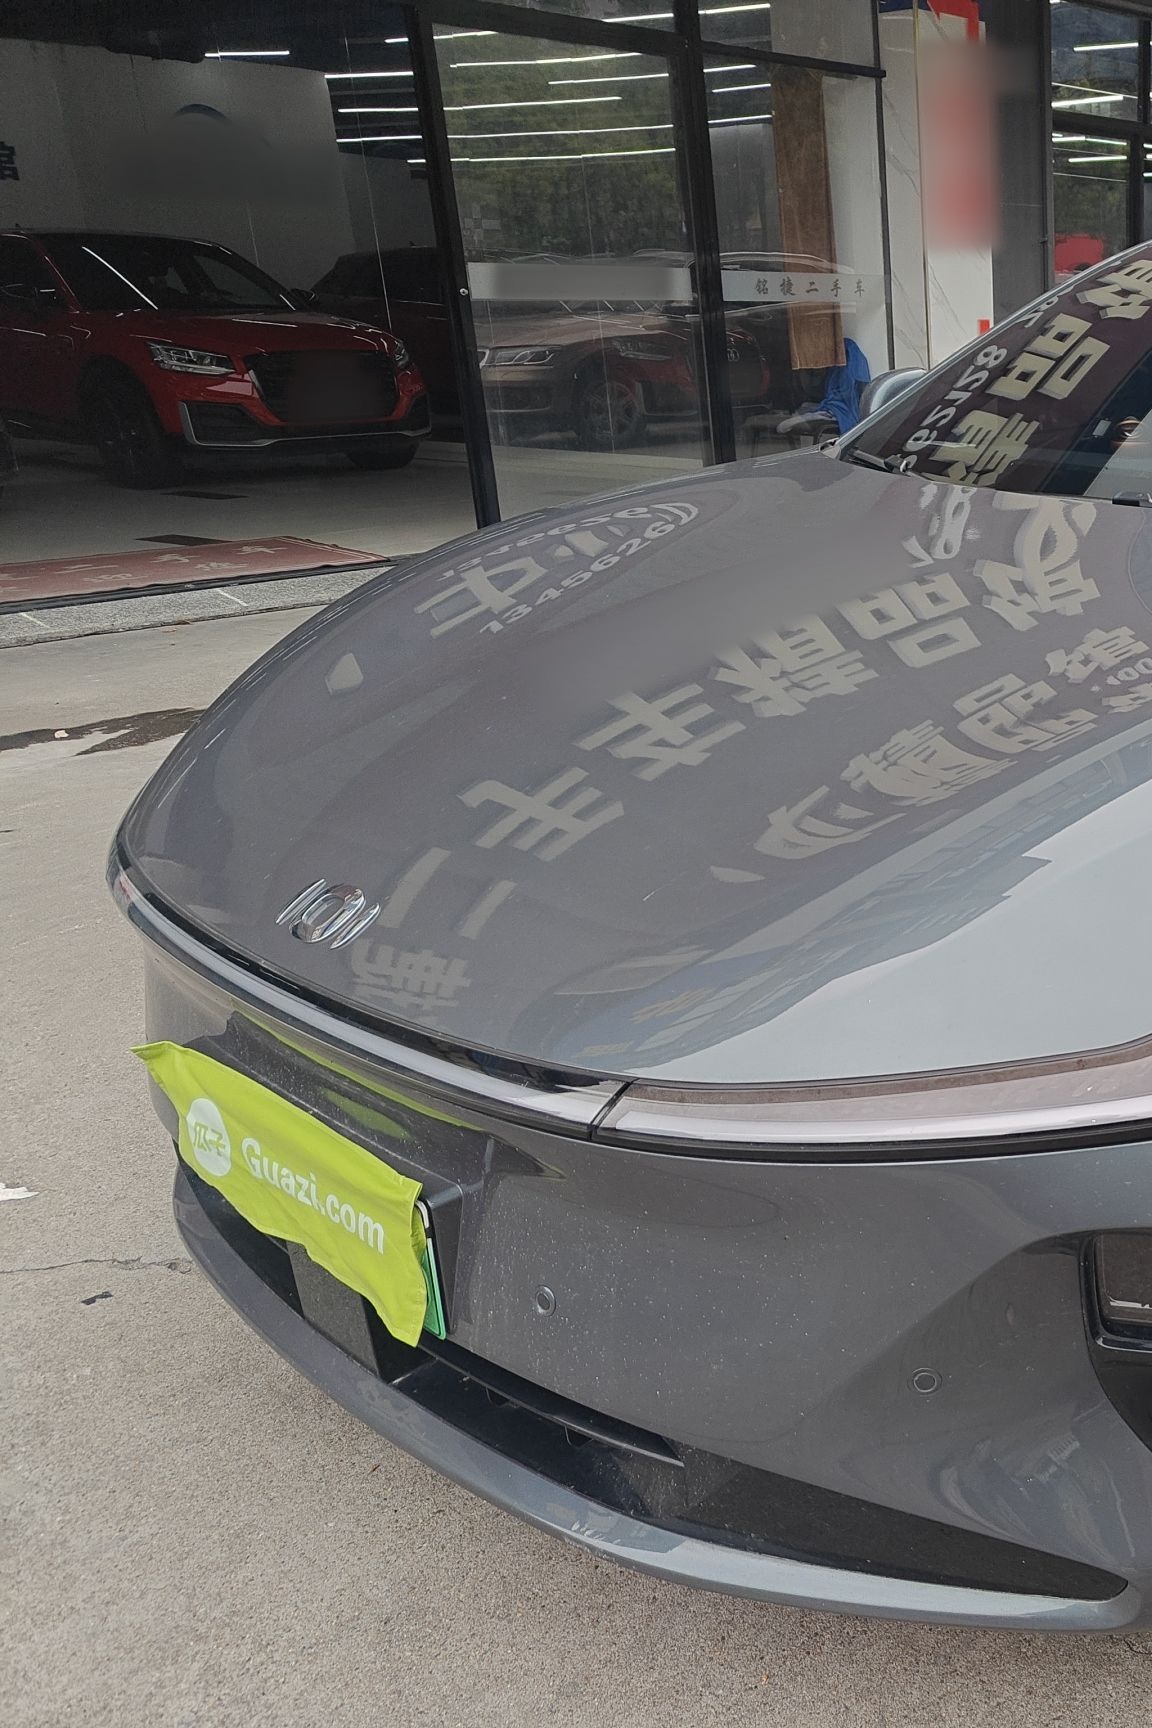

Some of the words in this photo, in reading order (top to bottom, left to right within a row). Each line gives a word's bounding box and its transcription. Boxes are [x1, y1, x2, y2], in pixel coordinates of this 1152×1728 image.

[755, 276, 865, 297] 铭捷二手车
[193, 1122, 227, 1157] 瓜子
[241, 1137, 385, 1255] Guazi.com
